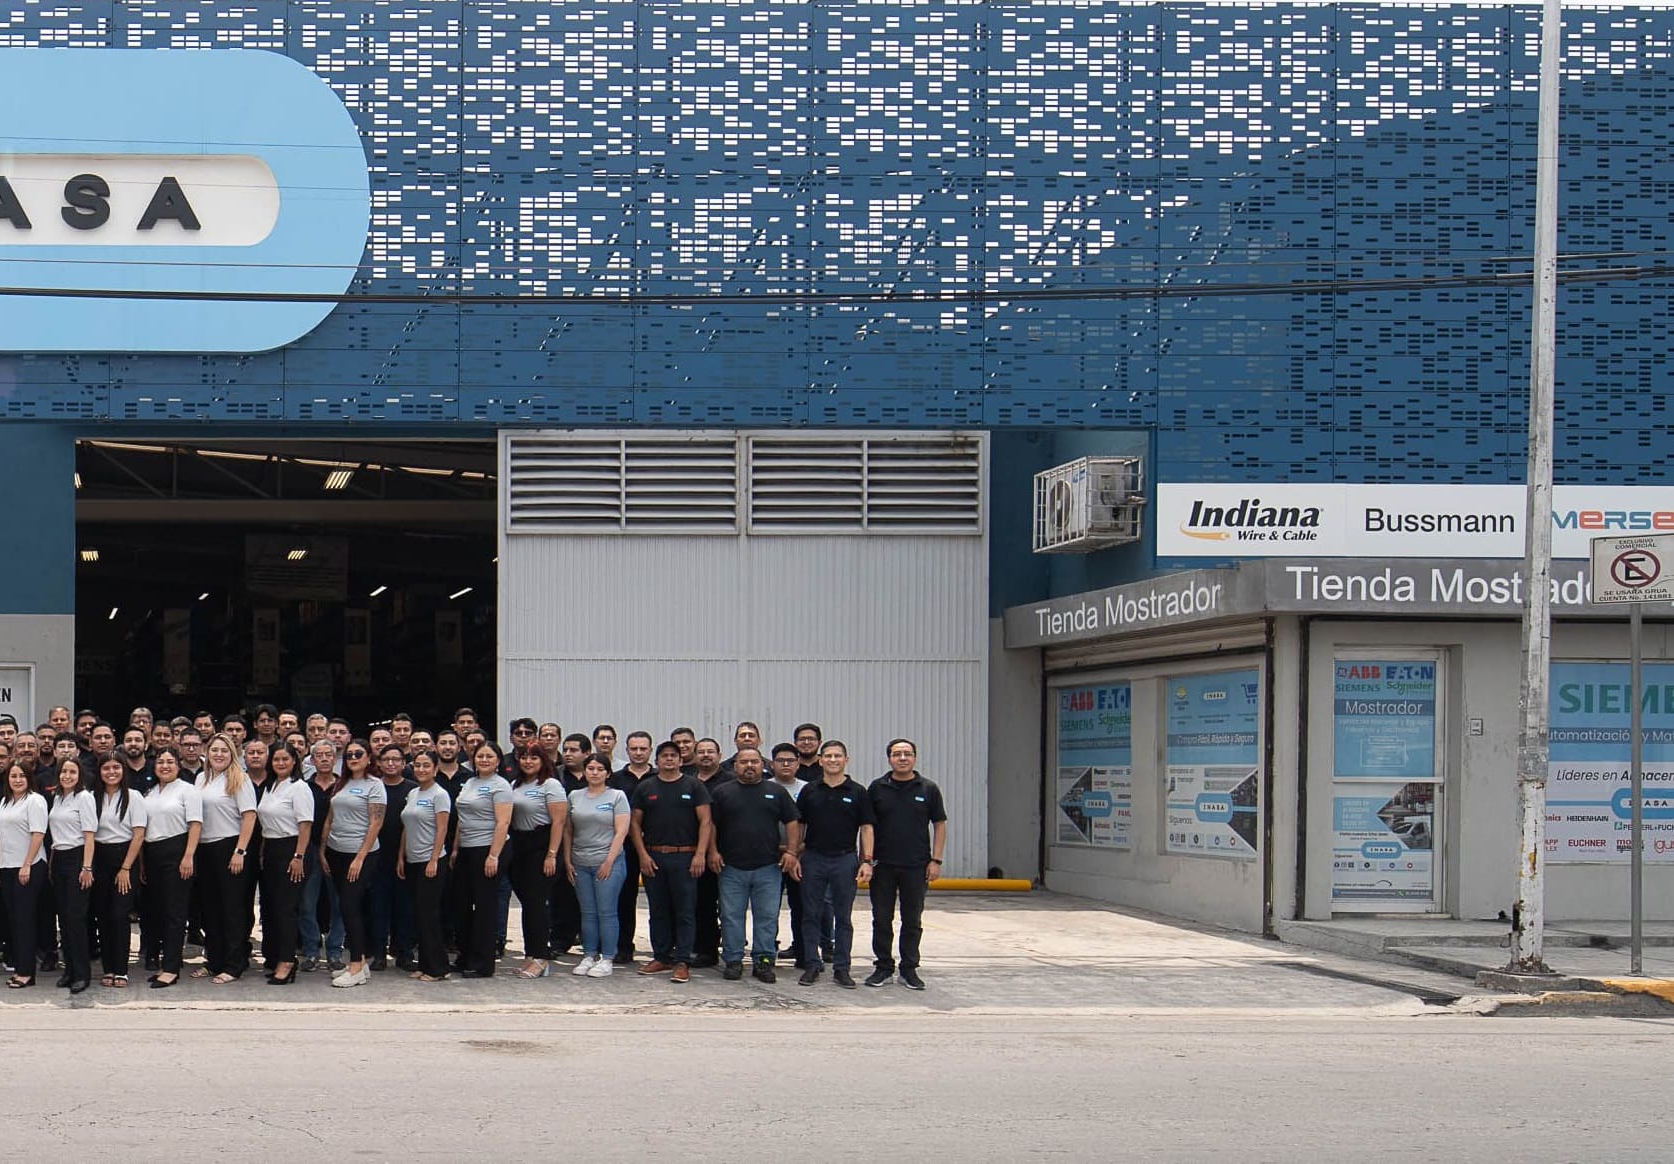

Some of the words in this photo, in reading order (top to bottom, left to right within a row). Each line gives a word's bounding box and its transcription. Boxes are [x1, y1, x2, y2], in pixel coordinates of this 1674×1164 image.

[1188, 498, 1321, 528] Indiana
[1365, 508, 1515, 534] Bussmann
[1237, 530, 1266, 541] Wire
[1269, 530, 1279, 541] &
[1282, 529, 1318, 541] Cable
[1285, 566, 1415, 602] Tienda
[1035, 602, 1098, 636] Tienda
[1105, 580, 1222, 627] Mostrador
[1348, 665, 1381, 679] ABB
[1345, 701, 1423, 715] Mostrador
[1549, 729, 1630, 741] utomatizació
[1652, 730, 1674, 741] Ma
[1602, 771, 1618, 781] en
[1567, 839, 1607, 847] EUCHNER
